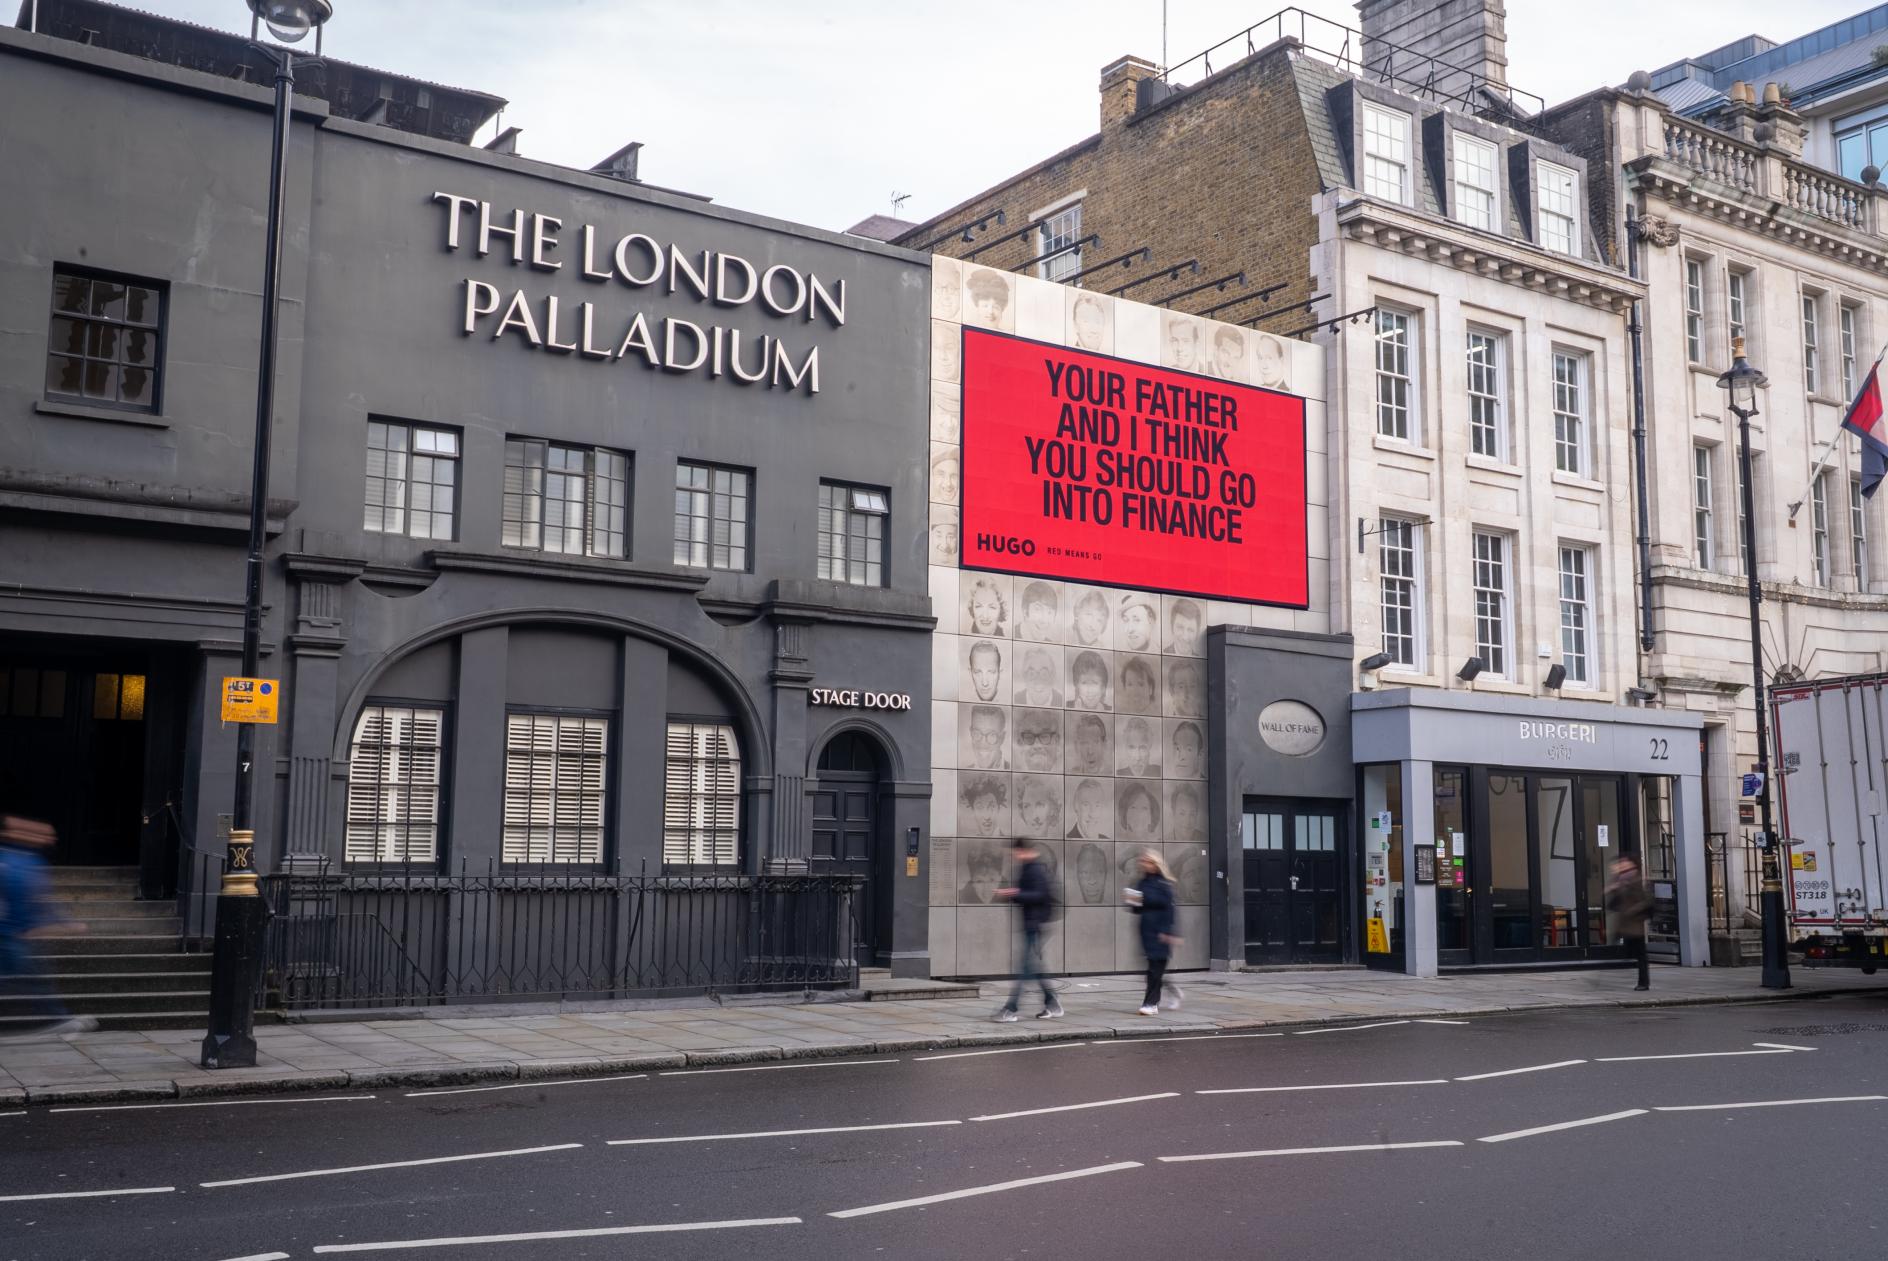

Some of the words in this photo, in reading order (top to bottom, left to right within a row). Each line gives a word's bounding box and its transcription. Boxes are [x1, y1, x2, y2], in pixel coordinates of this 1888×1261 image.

[433, 191, 563, 272] THE
[580, 223, 847, 327] LONDON
[462, 278, 821, 395] PALLADIUM
[1045, 359, 1126, 410] YOUR
[1136, 377, 1238, 431] FATHER
[1056, 402, 1121, 447] AND
[1130, 415, 1138, 451] I
[1145, 418, 1230, 467] THINK
[1024, 436, 1087, 482] YOU
[1096, 449, 1211, 501] SHOULD
[1219, 469, 1257, 509] GO
[1043, 479, 1113, 526] INTO
[1122, 492, 1243, 545] FINANCE
[977, 532, 1036, 557] HUGO
[1047, 546, 1062, 556] RED
[1065, 549, 1090, 559] MEANS
[1092, 552, 1102, 561] GO
[812, 688, 860, 707] STAGE
[864, 692, 912, 710] DOOR
[1261, 721, 1284, 733] WALL
[1285, 723, 1297, 733] OF
[1297, 724, 1319, 735] FAME
[1650, 738, 1670, 761] 22
[242, 762, 251, 773] 7
[1795, 891, 1828, 901] ST318
